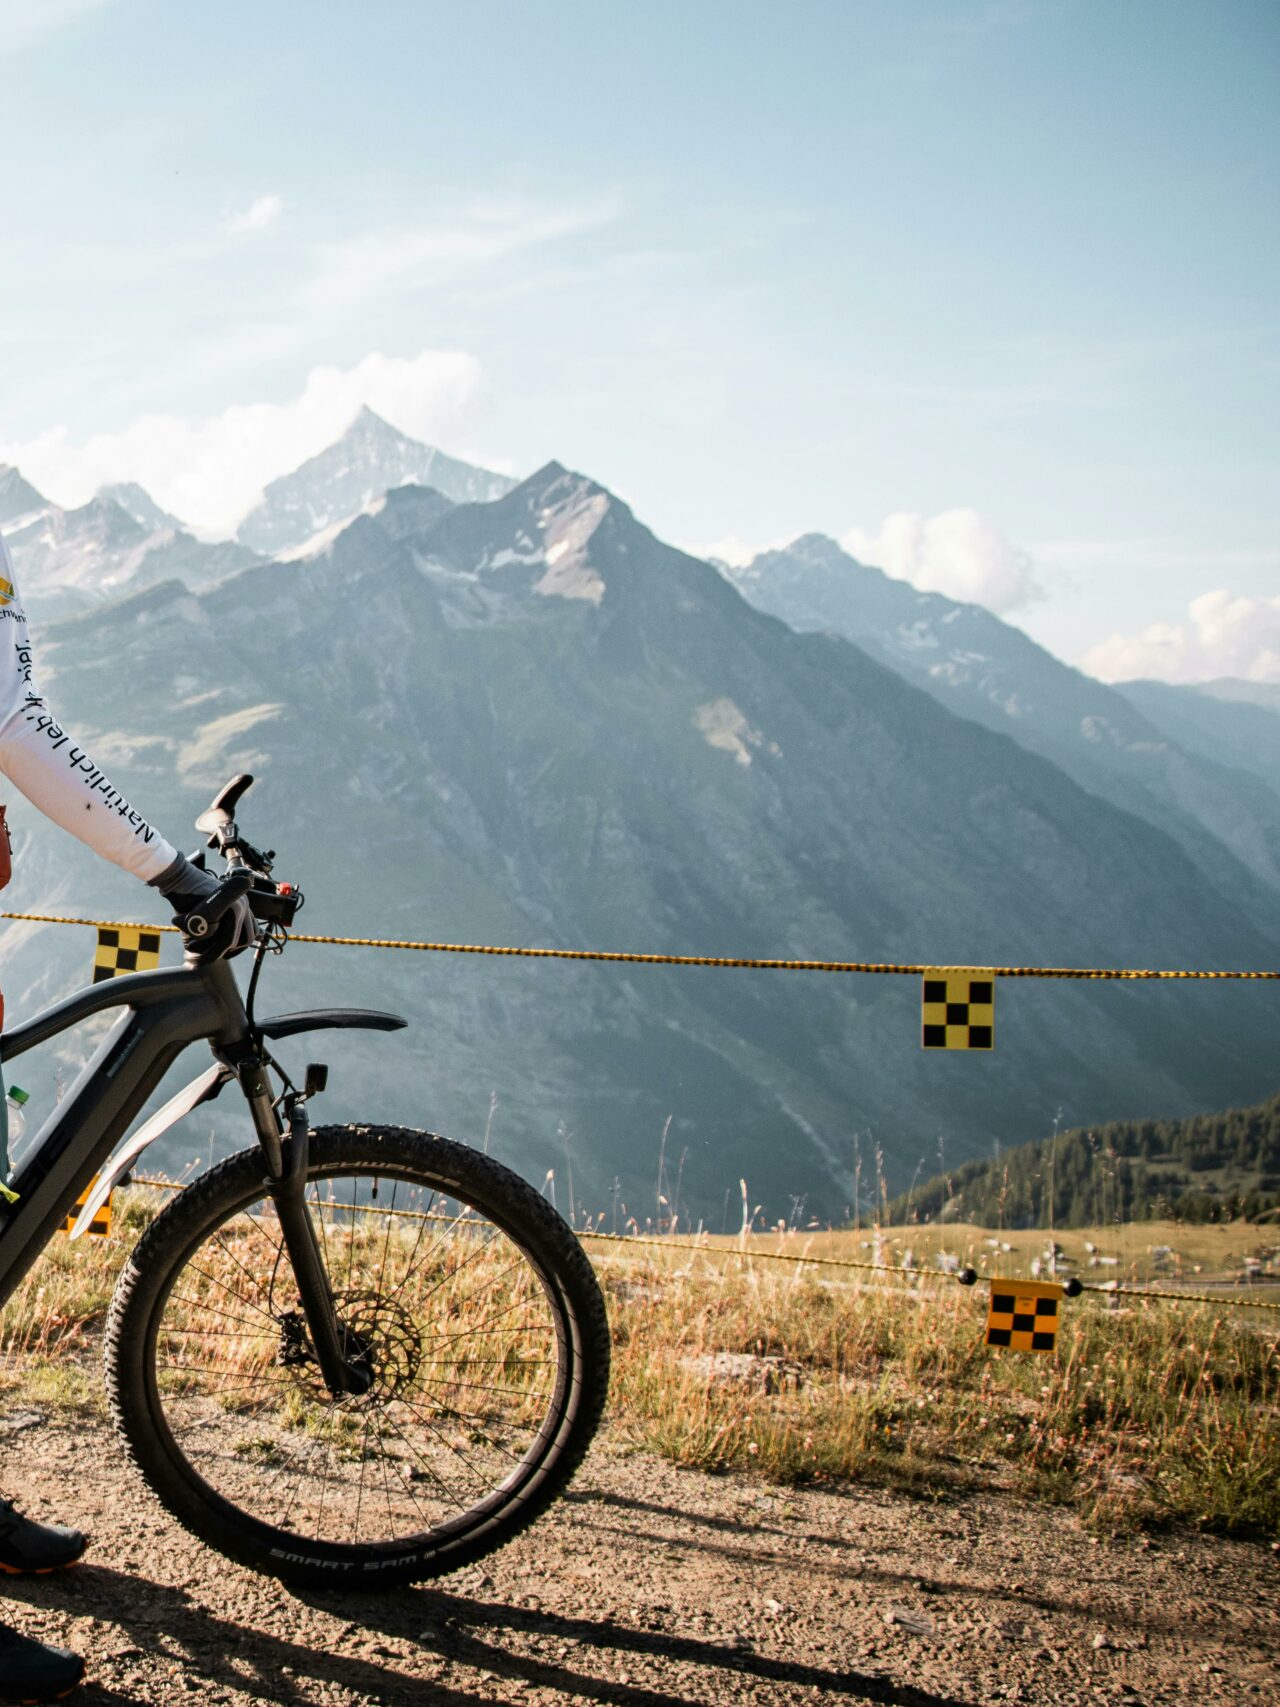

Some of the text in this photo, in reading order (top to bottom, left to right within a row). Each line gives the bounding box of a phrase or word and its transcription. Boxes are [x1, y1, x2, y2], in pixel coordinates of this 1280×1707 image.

[69, 747, 154, 843] Natürlich
[270, 1548, 355, 1571] SMART
[363, 1555, 418, 1571] SAM
